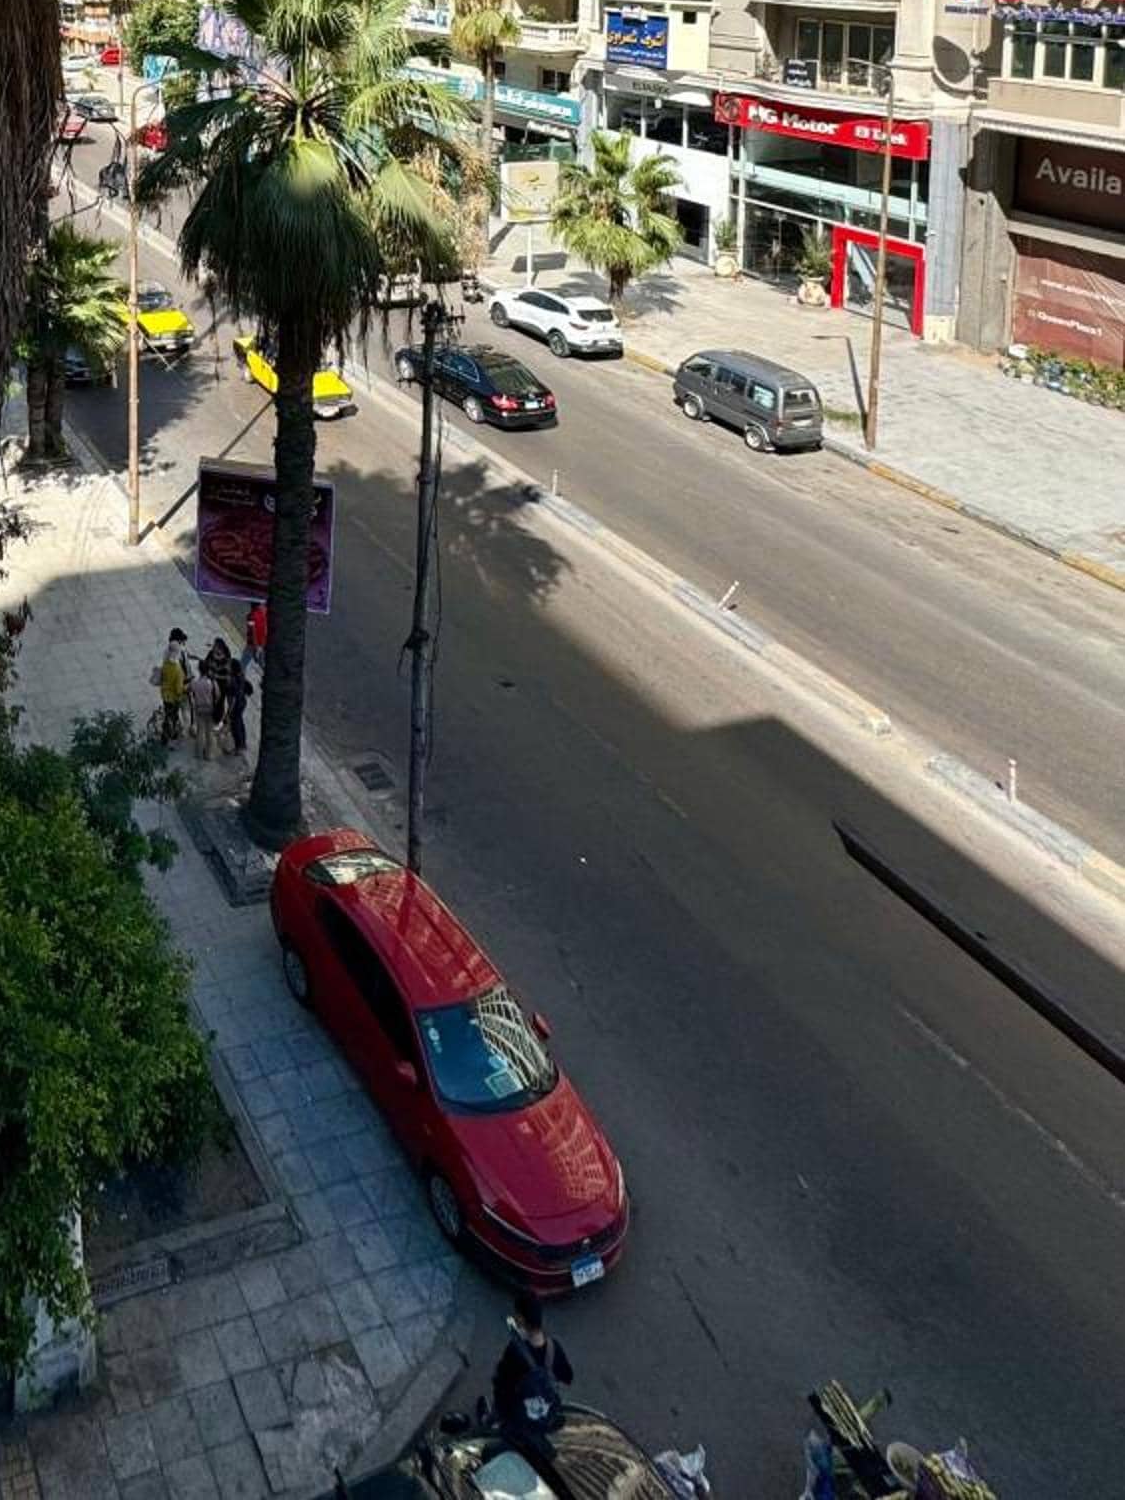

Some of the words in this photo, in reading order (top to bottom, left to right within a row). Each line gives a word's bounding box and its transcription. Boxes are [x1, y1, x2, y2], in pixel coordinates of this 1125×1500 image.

[748, 105, 778, 125] MG
[782, 111, 840, 135] Motor
[1035, 157, 1123, 195] Availa
